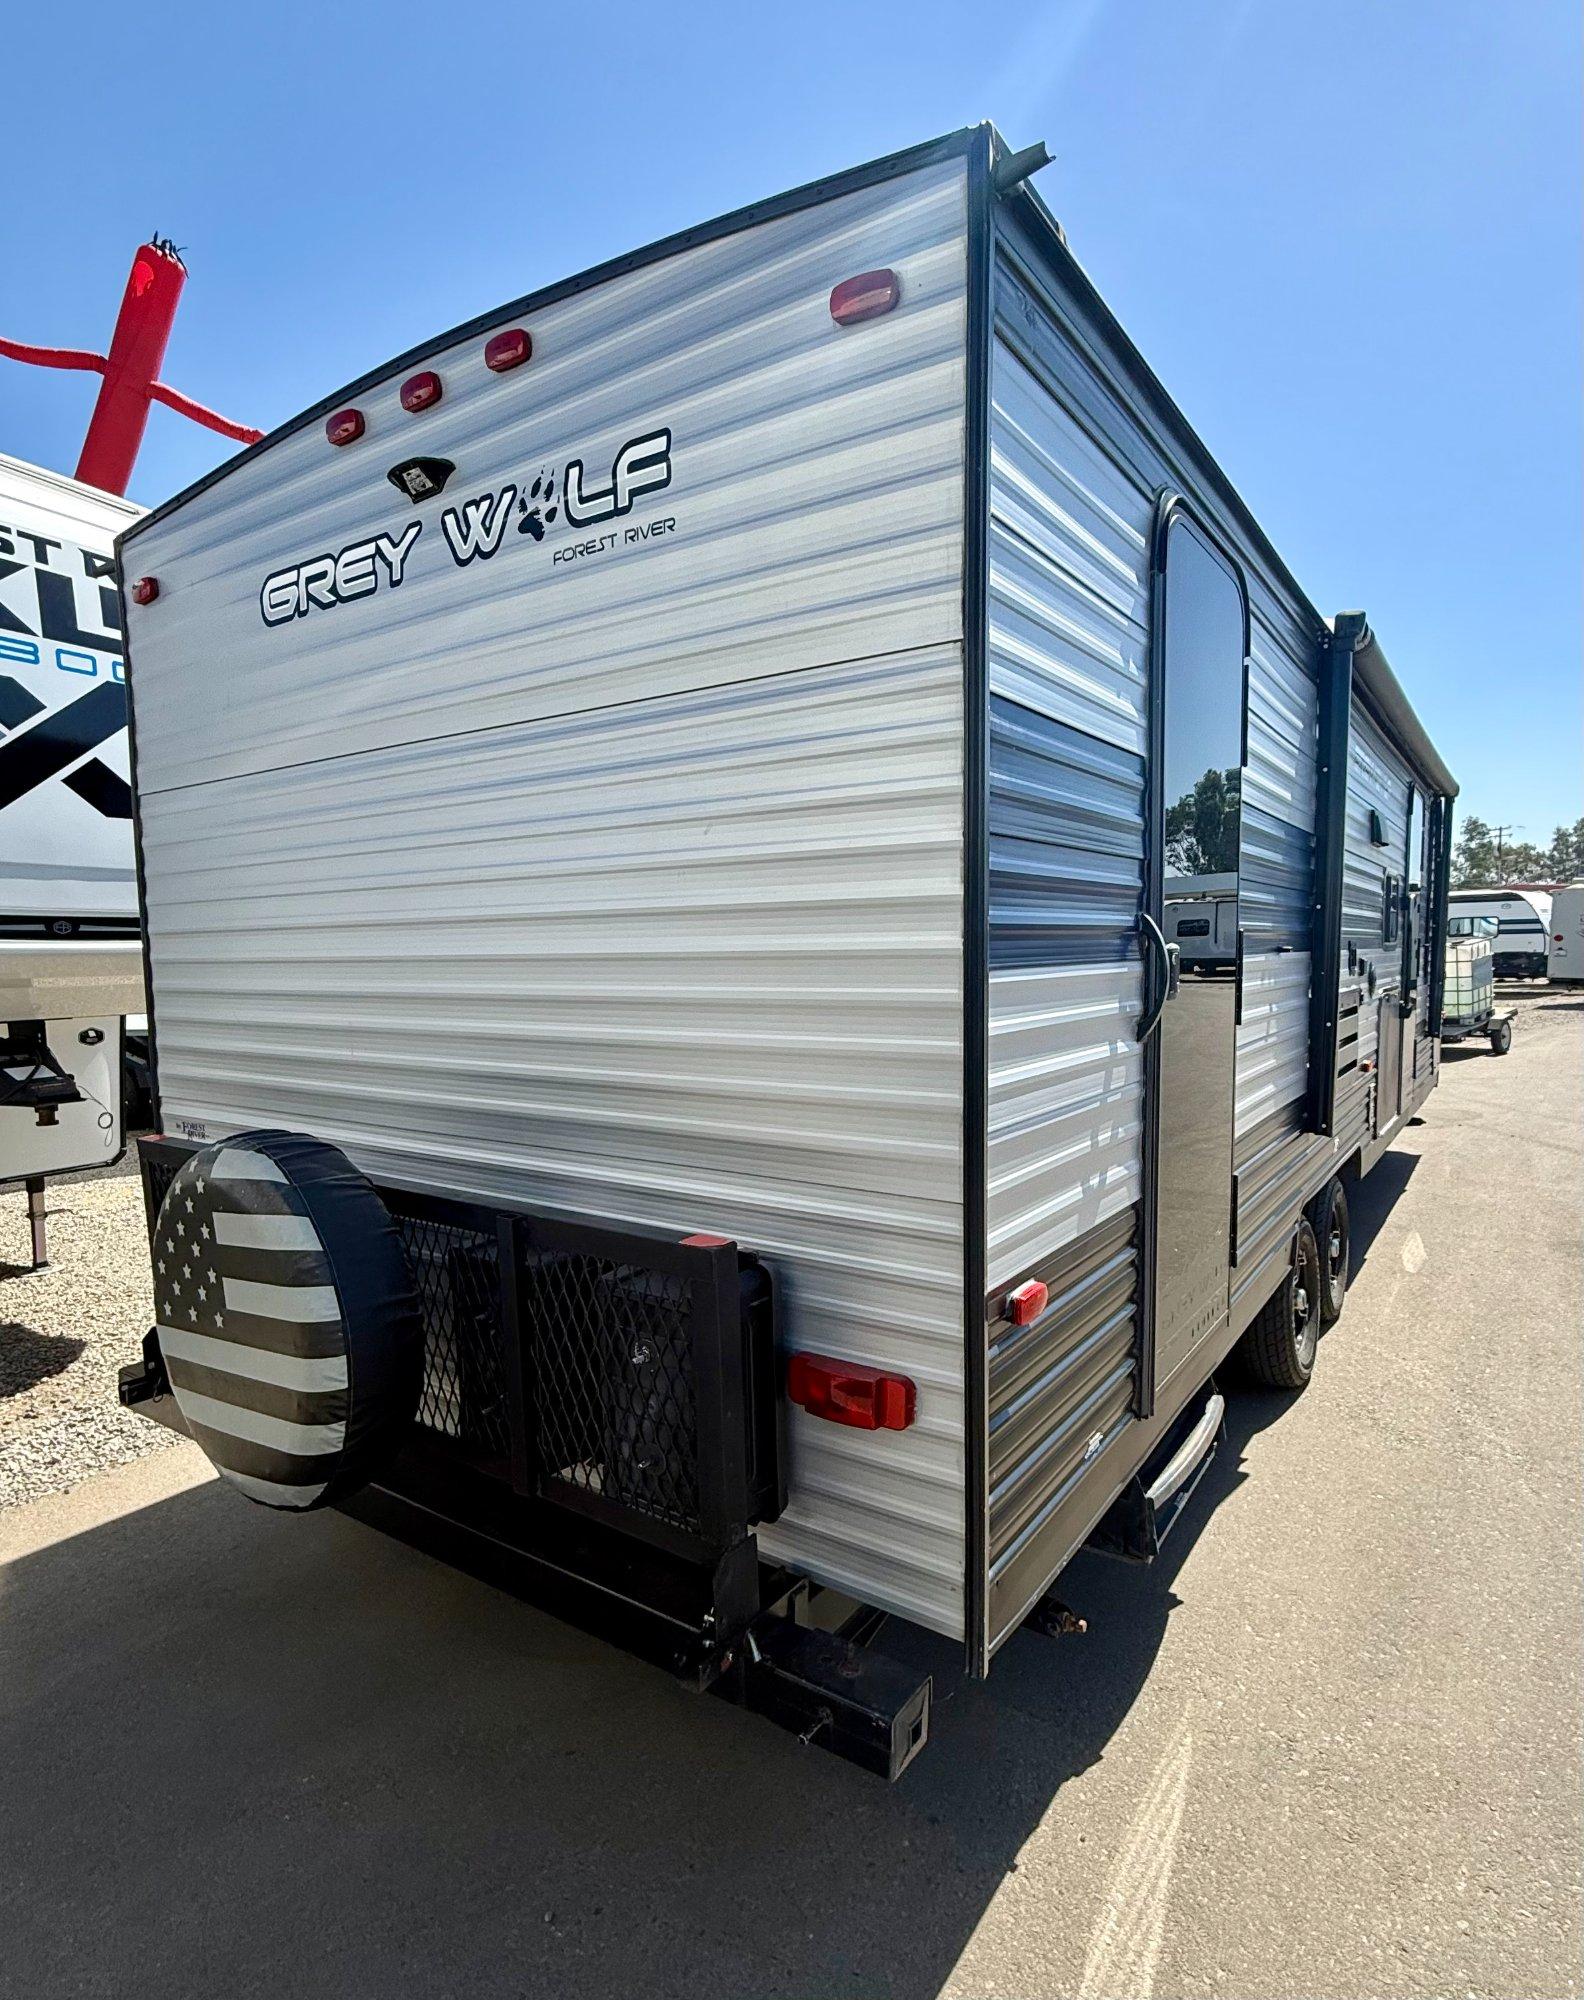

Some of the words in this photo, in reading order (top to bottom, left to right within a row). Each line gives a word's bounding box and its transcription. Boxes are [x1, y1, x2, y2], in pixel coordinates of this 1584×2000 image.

[260, 520, 422, 627] GREY
[553, 532, 617, 566] FOREST
[624, 517, 676, 544] RIVER
